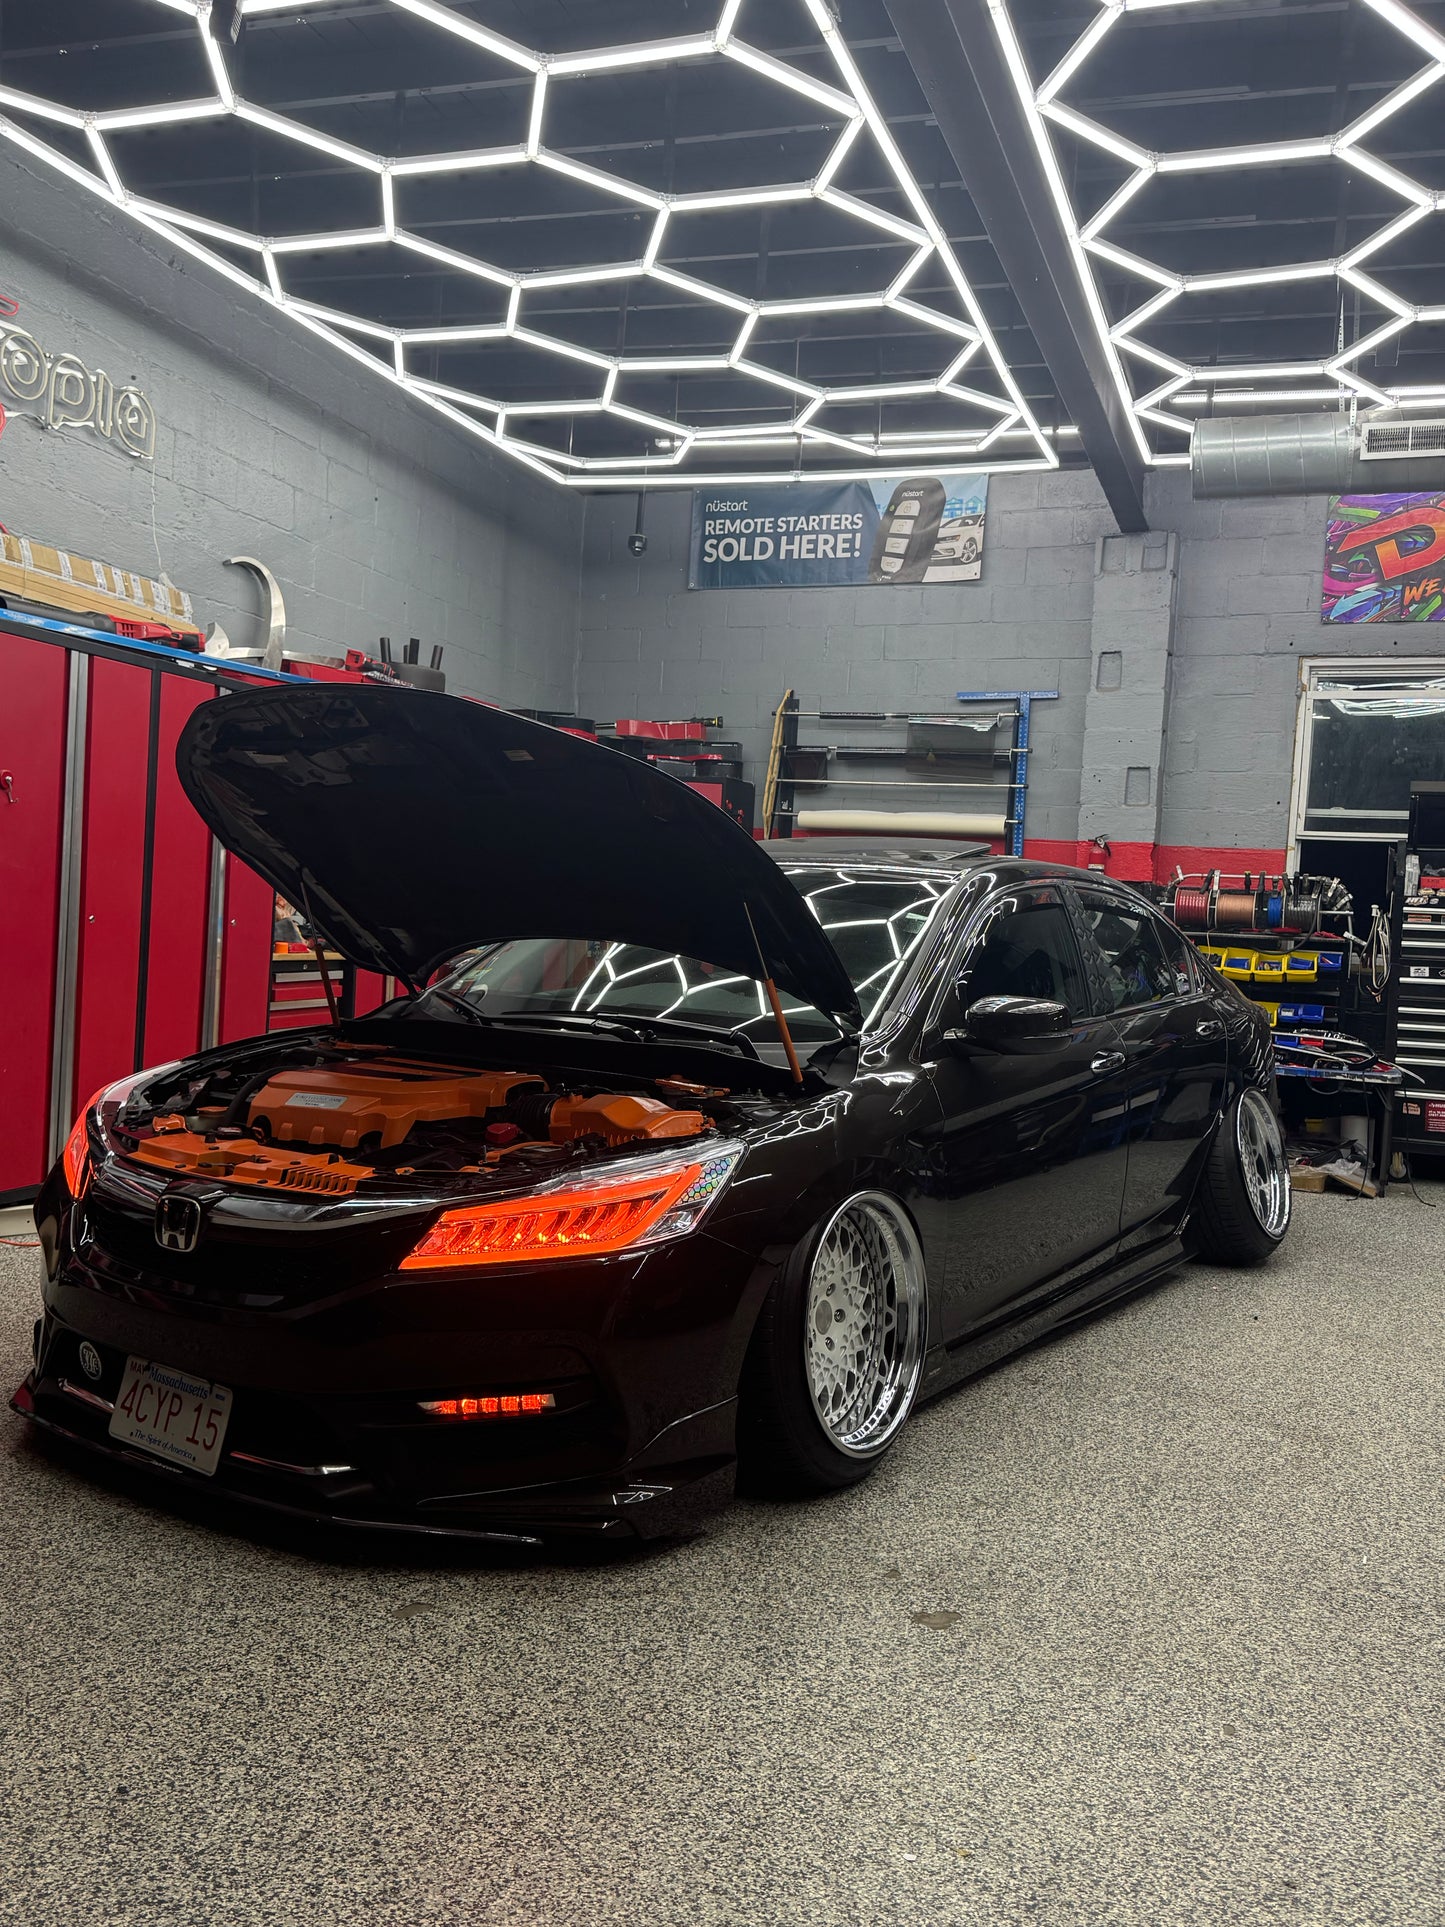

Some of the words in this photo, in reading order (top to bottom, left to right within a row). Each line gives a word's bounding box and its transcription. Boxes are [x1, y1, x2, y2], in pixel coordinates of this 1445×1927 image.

[705, 500, 748, 513] nüstart
[705, 517, 775, 536] REMOTE
[776, 513, 863, 533] STARTERS
[703, 536, 774, 563] SOLD
[779, 532, 862, 560] HERE!
[1403, 578, 1442, 606] WE
[130, 1360, 146, 1375] MAY
[149, 1366, 208, 1400] Massachusetts
[119, 1379, 183, 1433] 4CYP
[185, 1402, 222, 1451] 15
[133, 1429, 146, 1442] The
[146, 1434, 162, 1449] Spirit
[167, 1443, 193, 1460] America
